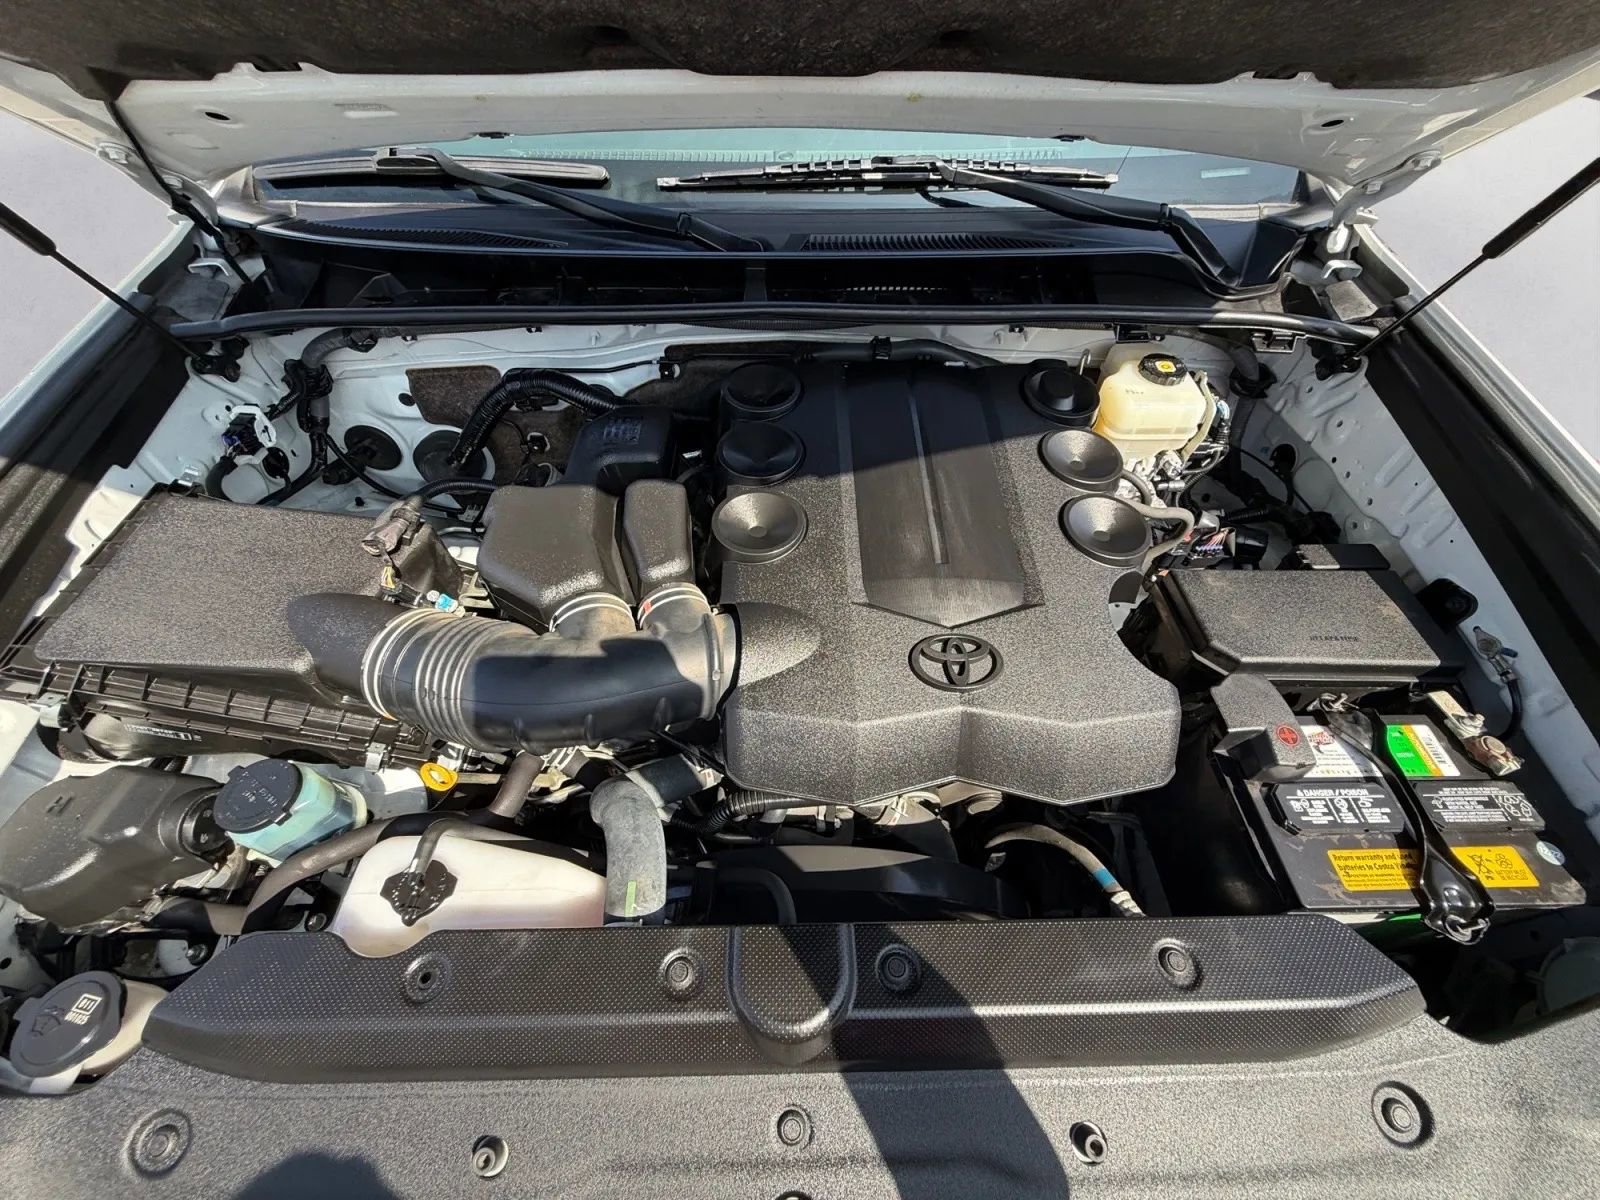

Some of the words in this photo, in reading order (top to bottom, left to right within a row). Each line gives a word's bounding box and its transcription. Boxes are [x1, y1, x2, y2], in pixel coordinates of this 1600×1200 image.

[1303, 789, 1335, 797] DANGER
[1332, 854, 1355, 862] Return
[1355, 854, 1384, 863] warranty
[1384, 852, 1398, 861] and
[1337, 863, 1365, 872] batteries
